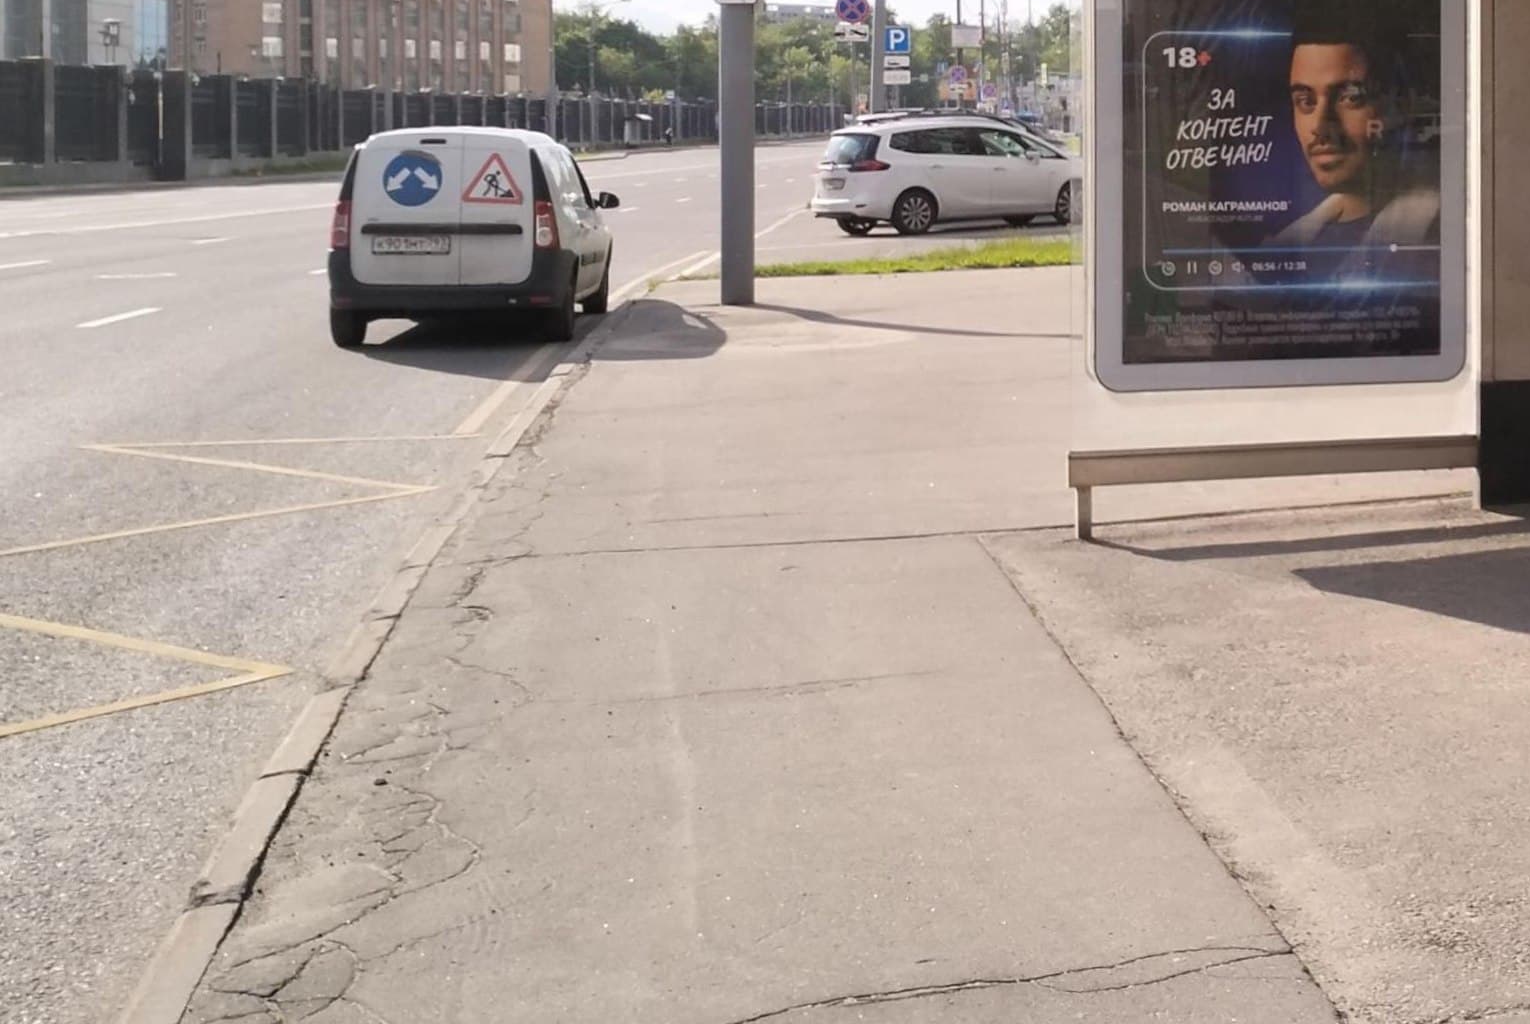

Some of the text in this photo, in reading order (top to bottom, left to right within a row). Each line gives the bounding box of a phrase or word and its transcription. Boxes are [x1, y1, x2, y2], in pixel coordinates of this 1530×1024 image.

[1163, 47, 1212, 68] 18+
[1208, 88, 1235, 110] ЗА
[1177, 115, 1272, 141] КОНТЕНТ
[1166, 142, 1272, 170] ОТВЕЧАЮ!
[1162, 200, 1288, 212] РОМАН КАГРАМАНОВ
